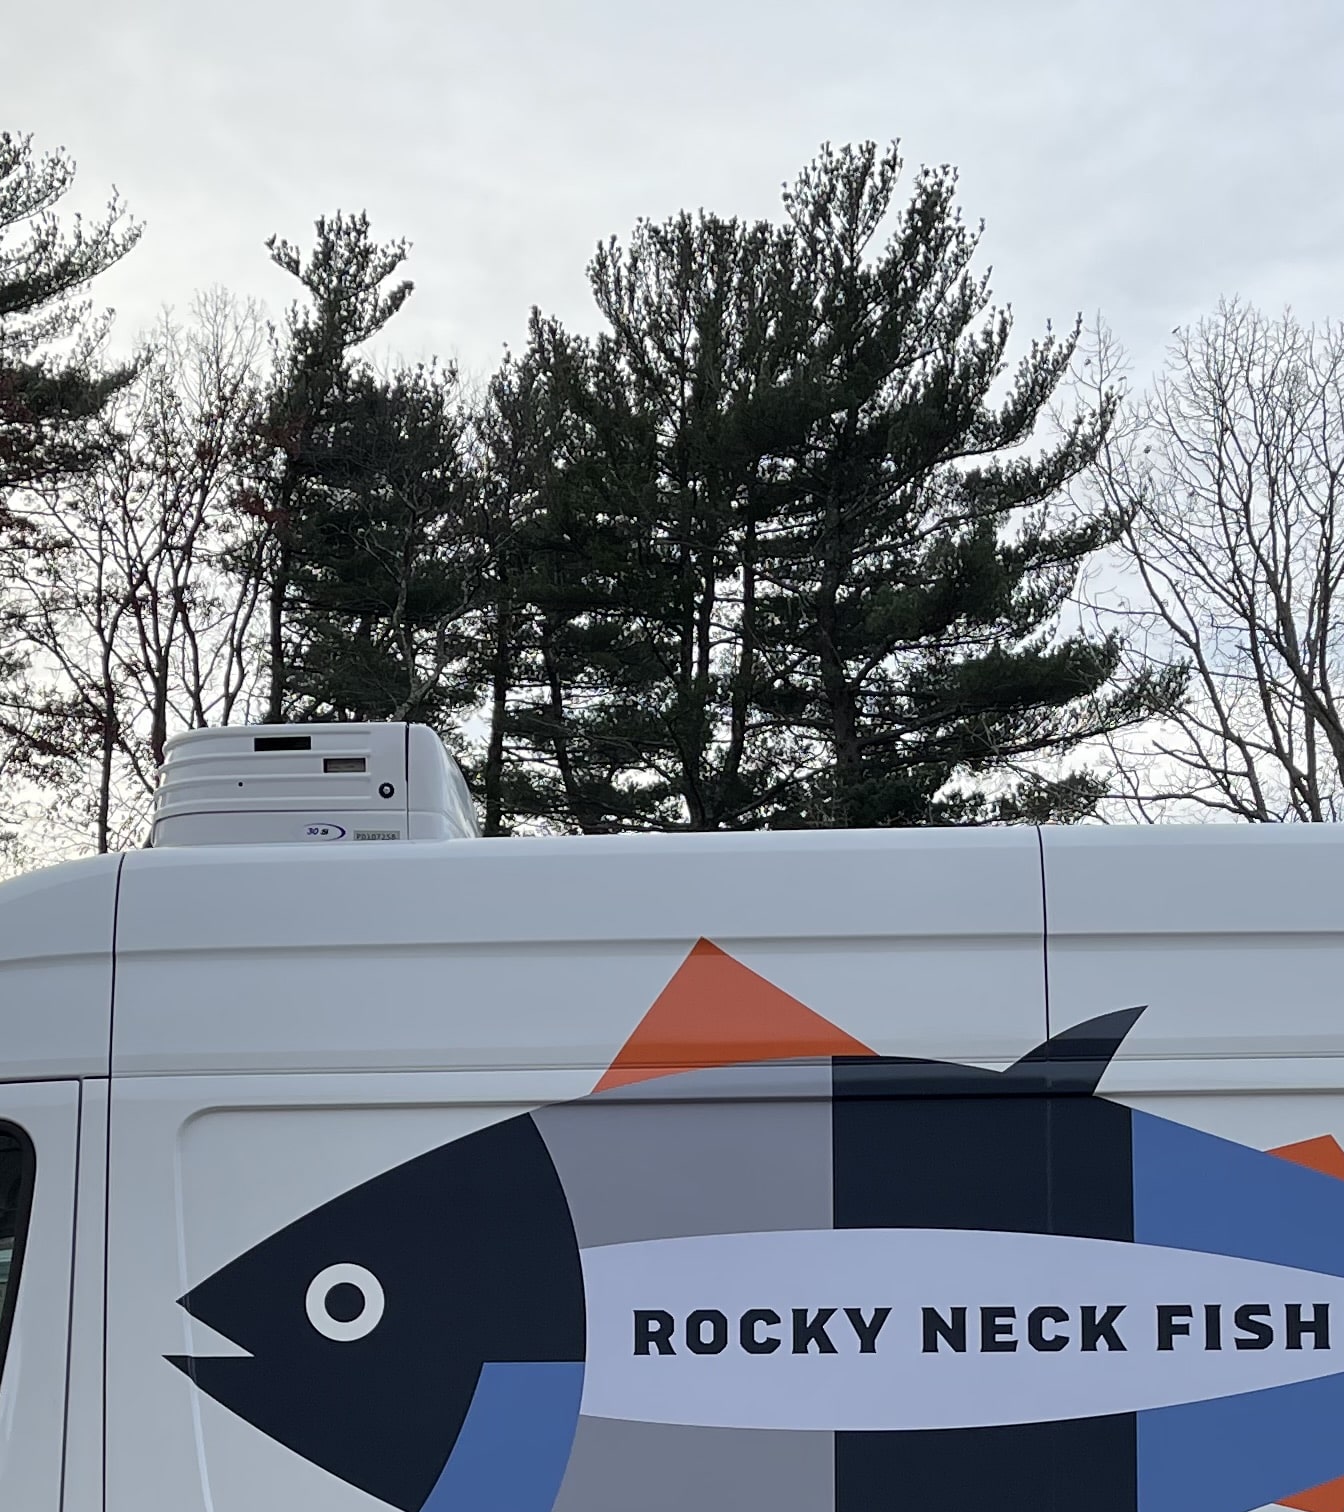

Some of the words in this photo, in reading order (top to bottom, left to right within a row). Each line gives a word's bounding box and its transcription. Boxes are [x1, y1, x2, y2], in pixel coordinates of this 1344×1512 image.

[633, 1308, 892, 1355] ROCKY
[921, 1305, 1127, 1353] NECK
[1156, 1303, 1331, 1351] FISH
